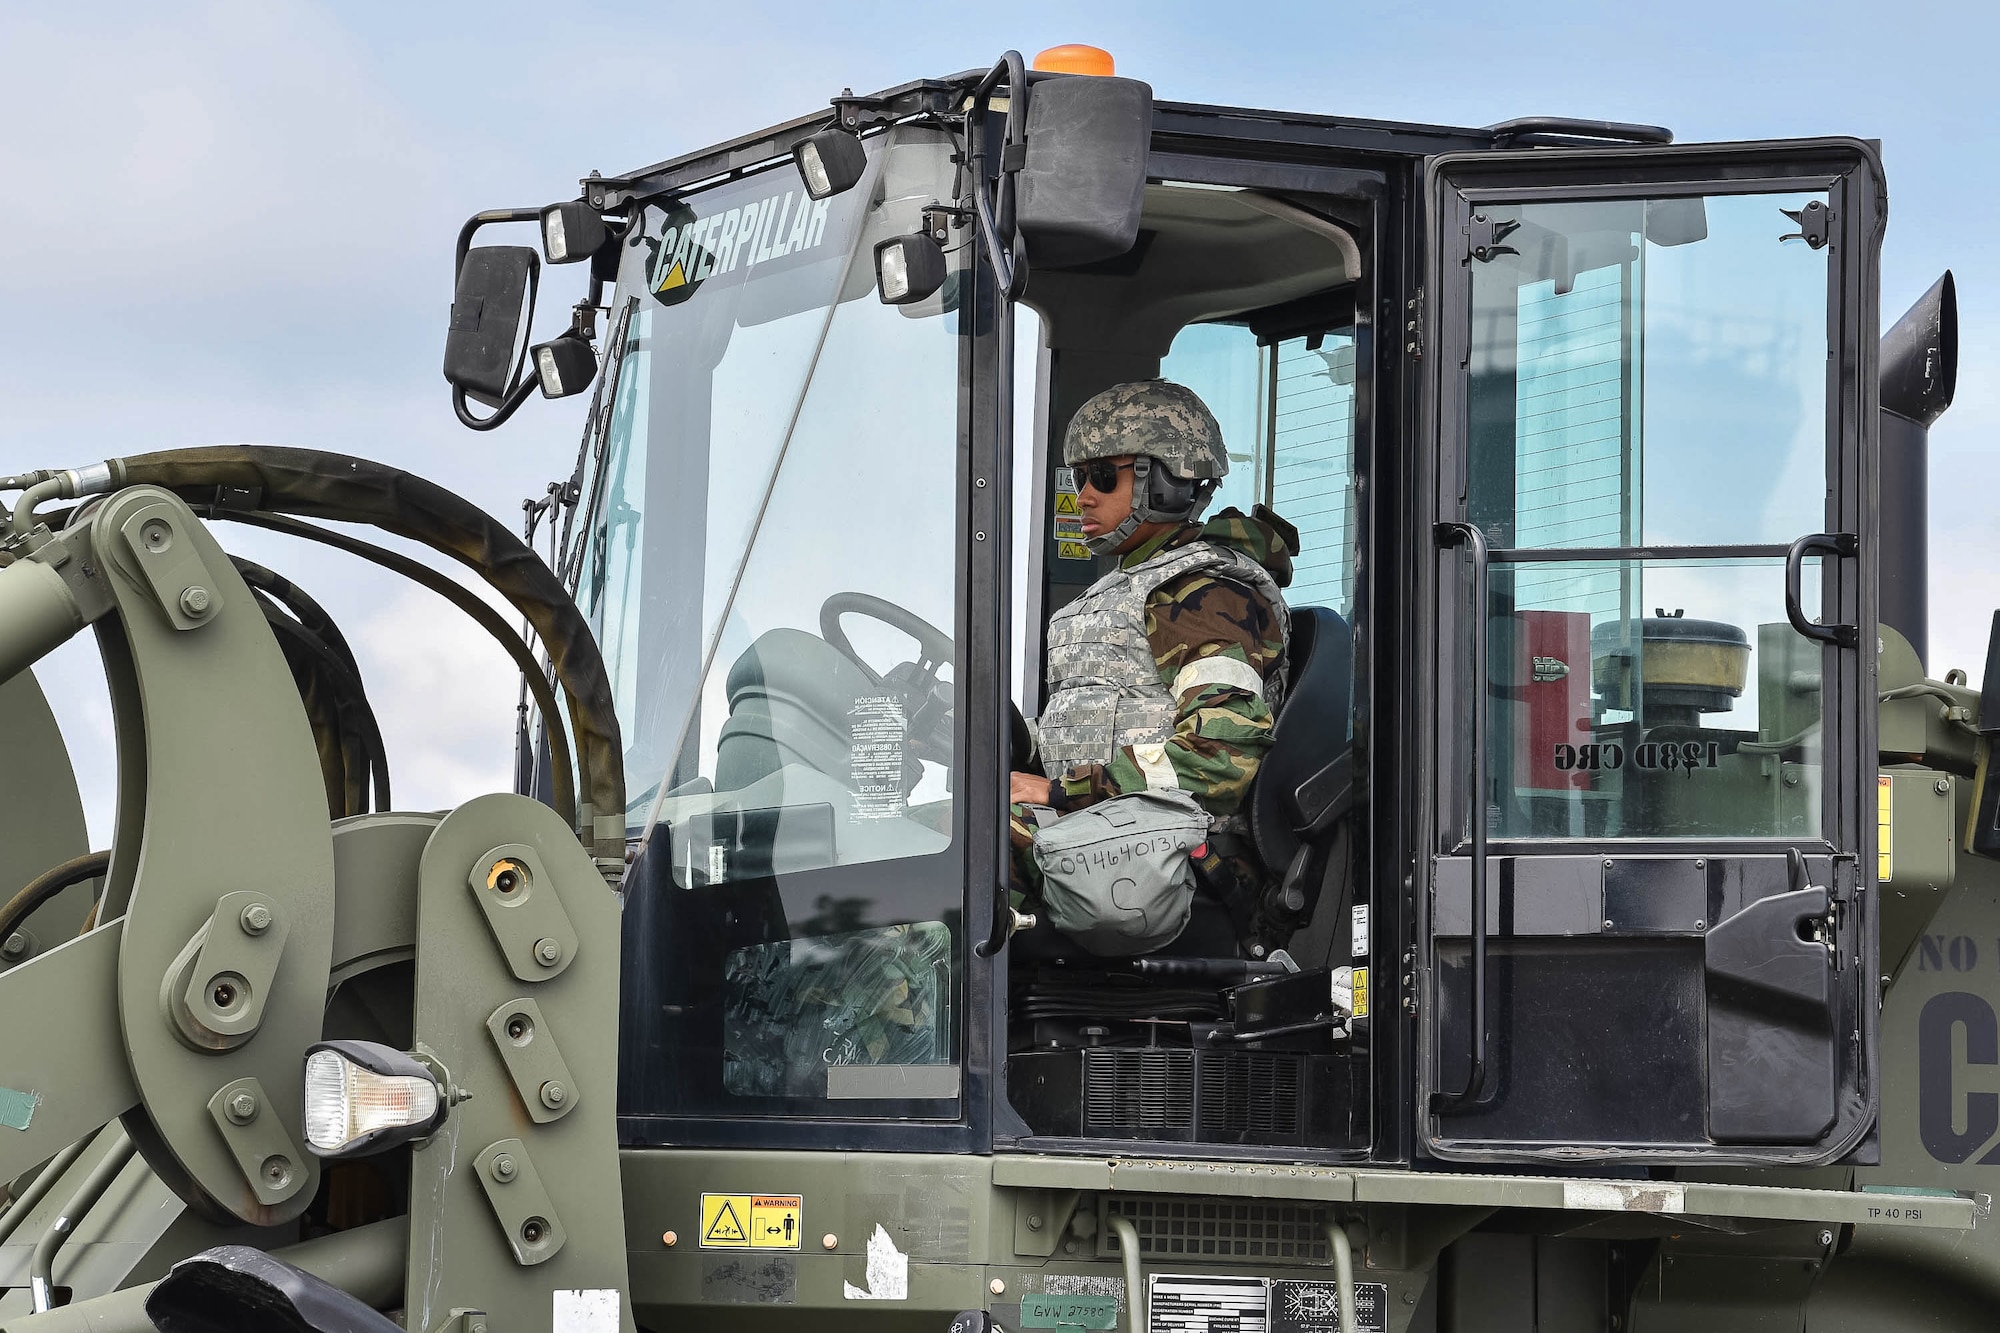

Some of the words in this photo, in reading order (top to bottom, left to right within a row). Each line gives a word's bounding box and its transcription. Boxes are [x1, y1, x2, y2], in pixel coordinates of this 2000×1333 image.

[650, 190, 832, 294] CATERPILLAR
[1918, 934, 1978, 972] NO
[1867, 1208, 1882, 1218] TP
[1885, 1208, 1900, 1219] 40
[1906, 1209, 1922, 1220] PSI
[1034, 1304, 1062, 1318] GVW
[1068, 1305, 1104, 1318] 27580
